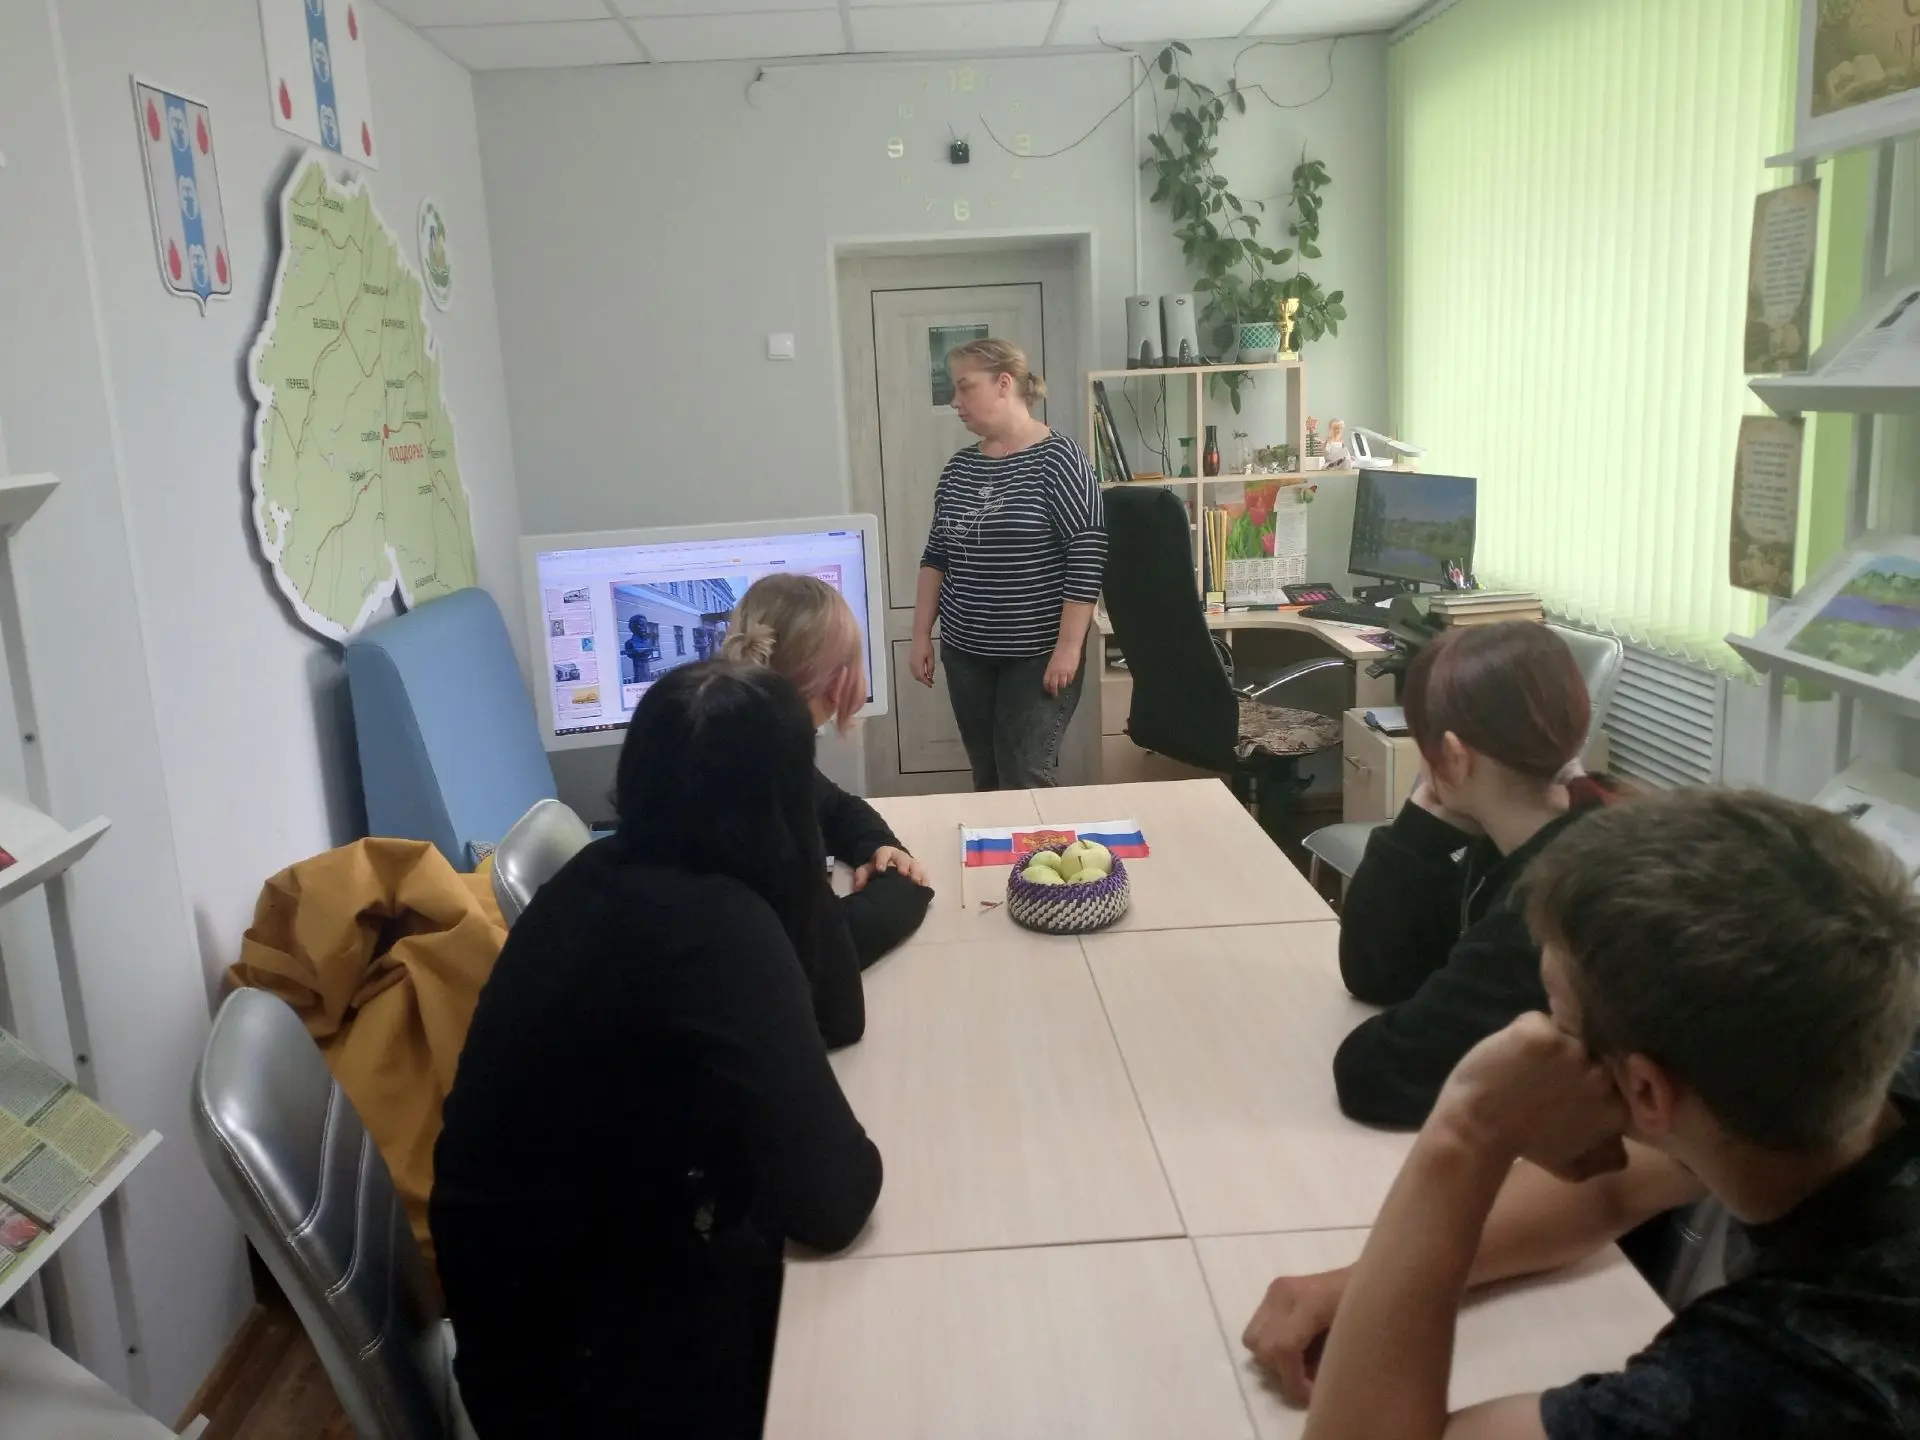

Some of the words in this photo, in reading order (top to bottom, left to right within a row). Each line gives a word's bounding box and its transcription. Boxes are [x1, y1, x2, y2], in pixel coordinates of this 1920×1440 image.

[949, 66, 974, 91] 12
[887, 136, 904, 159] 9
[953, 200, 971, 221] 6
[388, 443, 424, 464] ПОДДОРЬЕ
